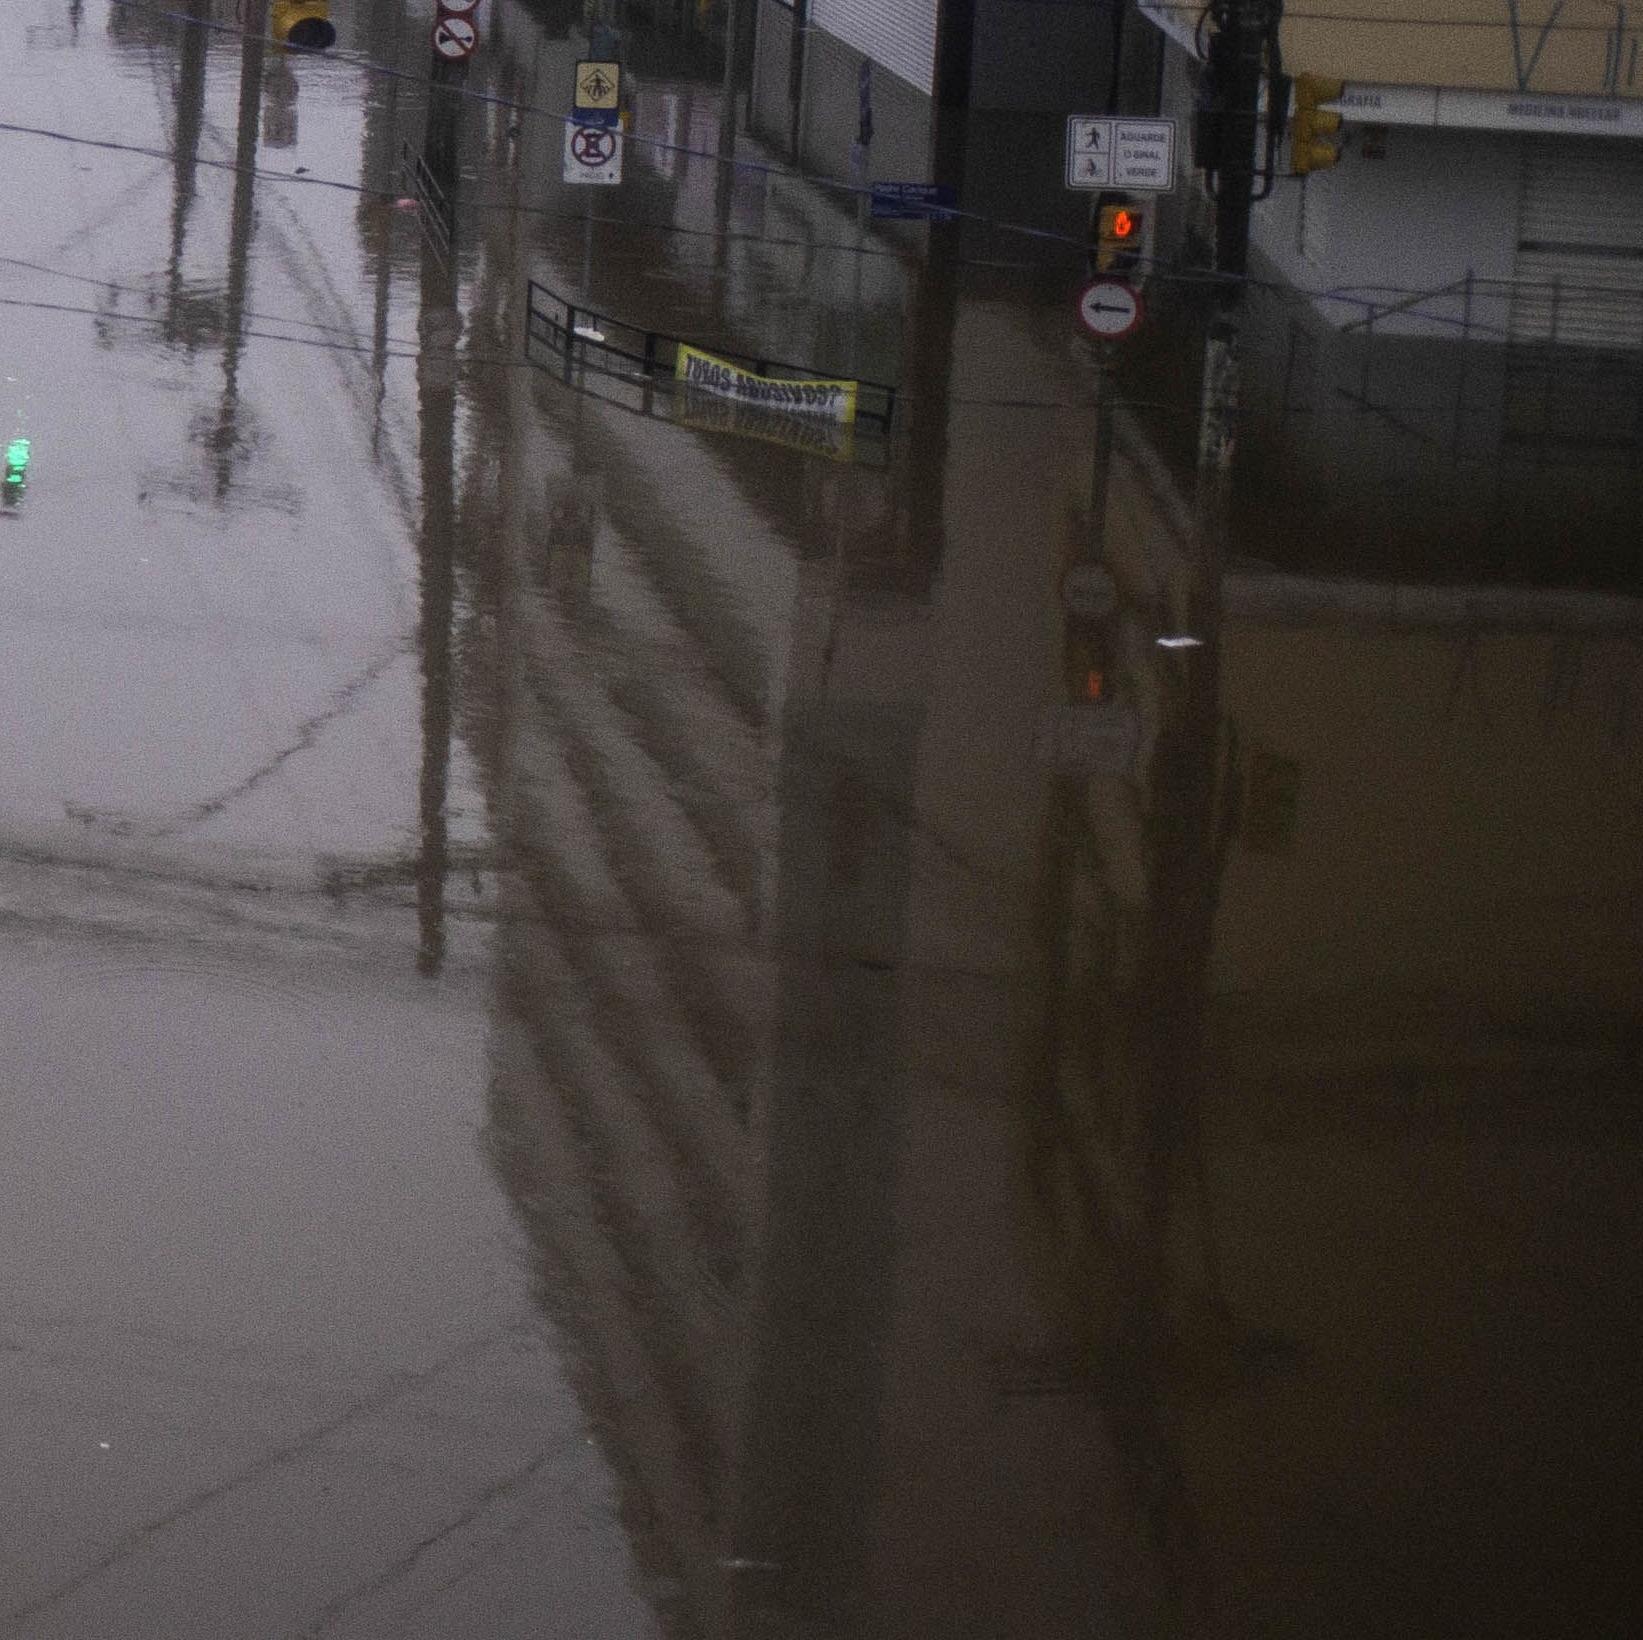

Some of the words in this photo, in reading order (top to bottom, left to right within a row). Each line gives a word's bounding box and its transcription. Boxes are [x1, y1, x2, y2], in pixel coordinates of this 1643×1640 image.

[1120, 132, 1166, 143] AGUARDE
[1134, 150, 1161, 160] SINAL
[1125, 167, 1158, 178] VERDE
